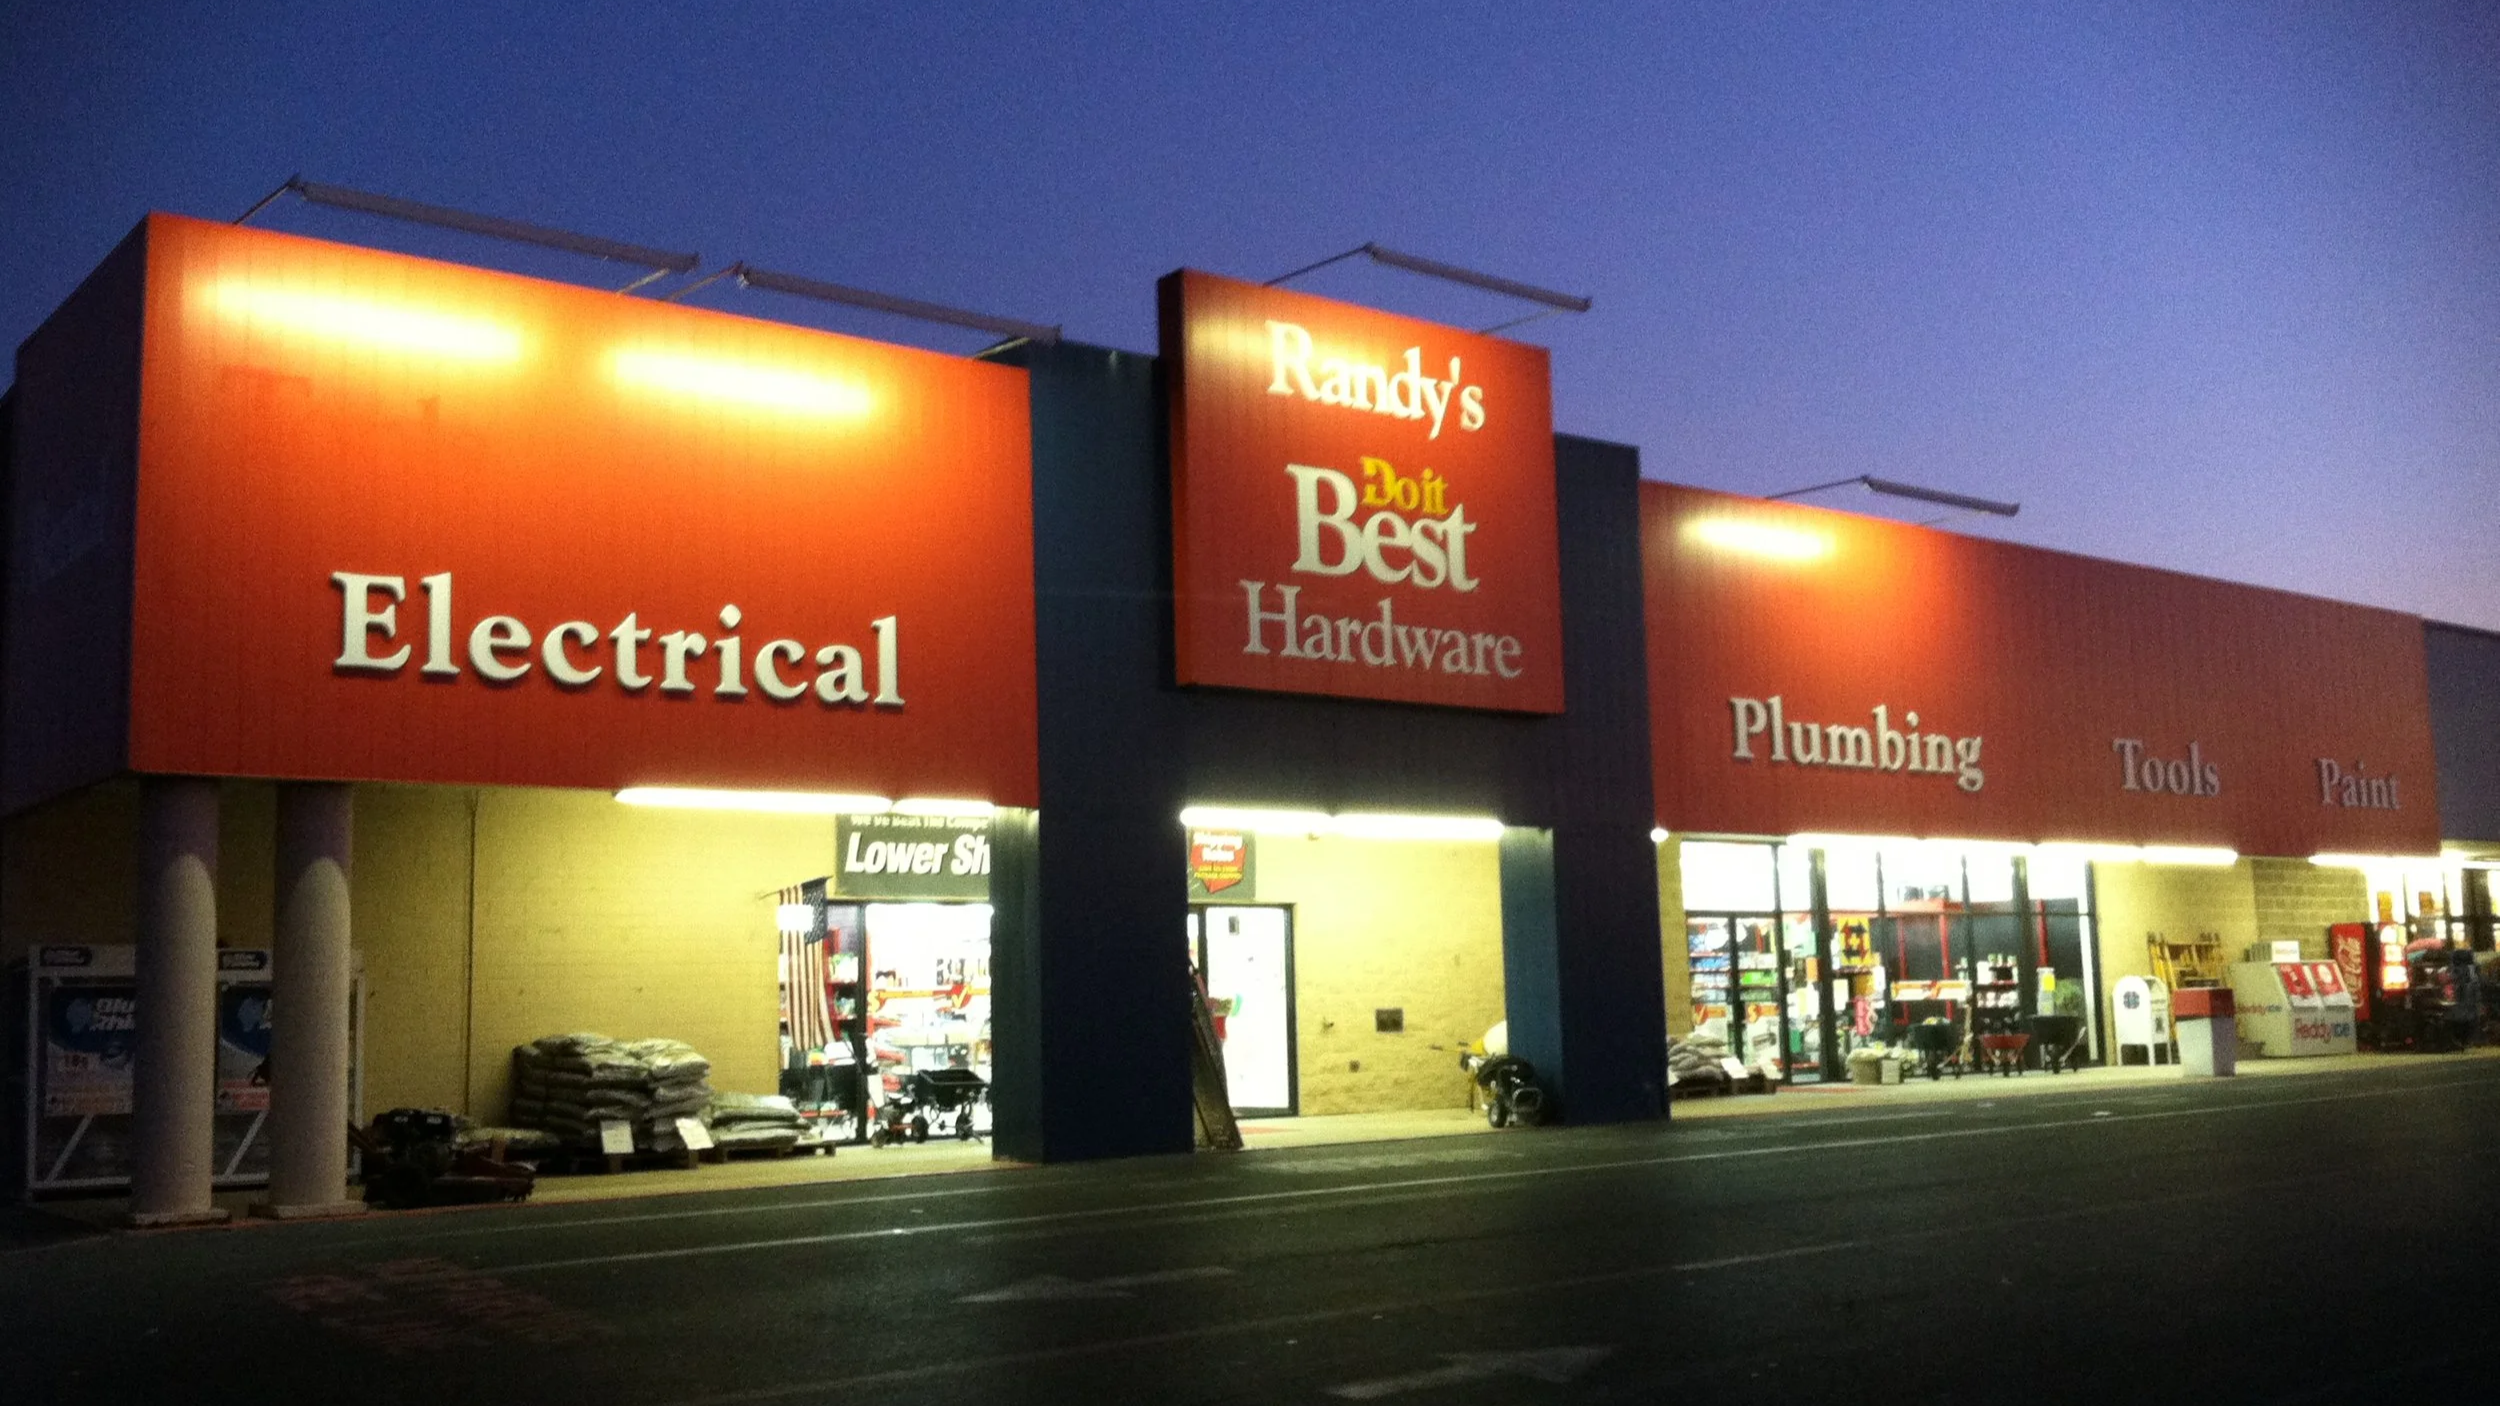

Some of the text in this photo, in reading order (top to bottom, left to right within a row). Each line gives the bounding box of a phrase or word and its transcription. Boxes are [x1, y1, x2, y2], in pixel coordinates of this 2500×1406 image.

[1266, 319, 1486, 440] Randy's
[1285, 462, 1480, 593] Best
[331, 570, 906, 706] Electrical
[1239, 578, 1524, 680] Hardware
[1730, 695, 1985, 792] Plumbing
[2112, 737, 2220, 796] Tools
[2315, 757, 2400, 810] Paint
[844, 831, 950, 875] Lower
